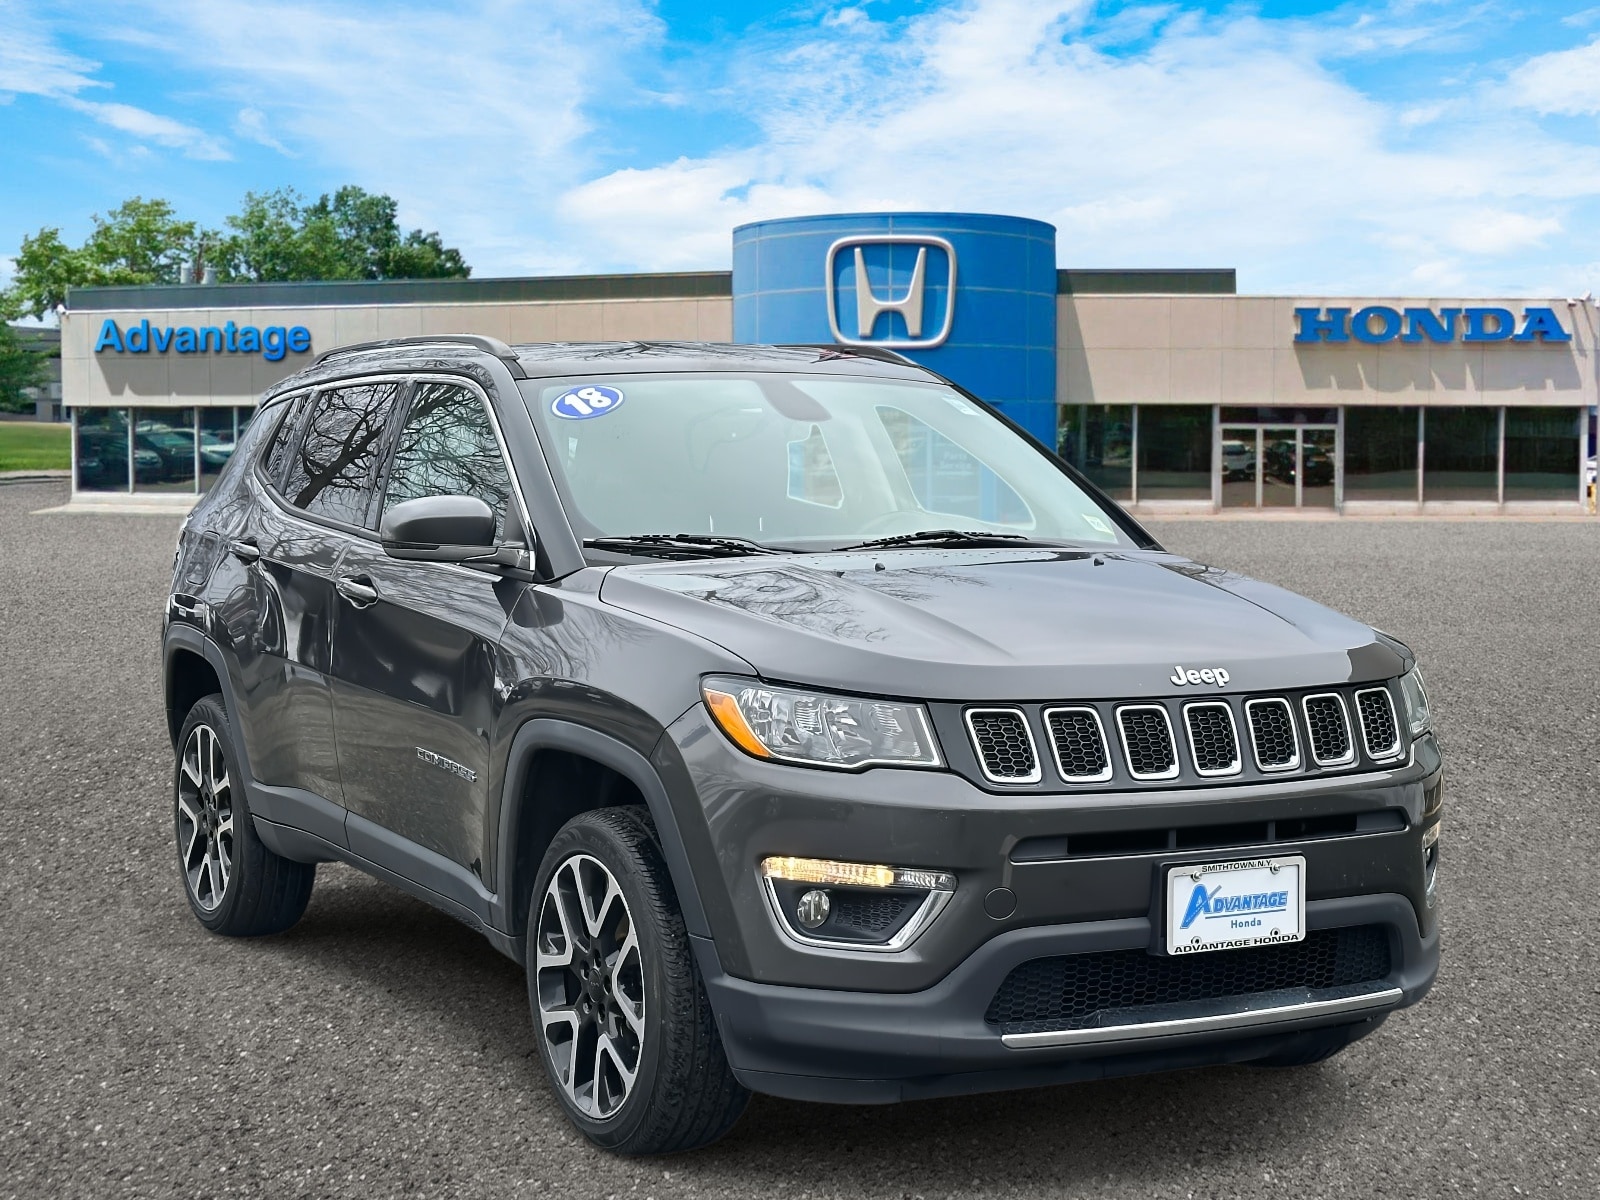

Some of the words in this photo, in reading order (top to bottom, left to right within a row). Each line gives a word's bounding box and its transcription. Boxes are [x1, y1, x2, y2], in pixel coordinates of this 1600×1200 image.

[95, 319, 311, 361] Advantage
[1294, 306, 1572, 343] HONDA
[564, 387, 612, 415] 18
[1169, 665, 1230, 688] Jeep
[416, 746, 477, 782] COMPASS
[1180, 884, 1288, 929] ADVANTAGE
[1230, 918, 1262, 929] Honda
[1174, 939, 1251, 954] ADVANTAGE
[1253, 934, 1300, 945] HONDA
